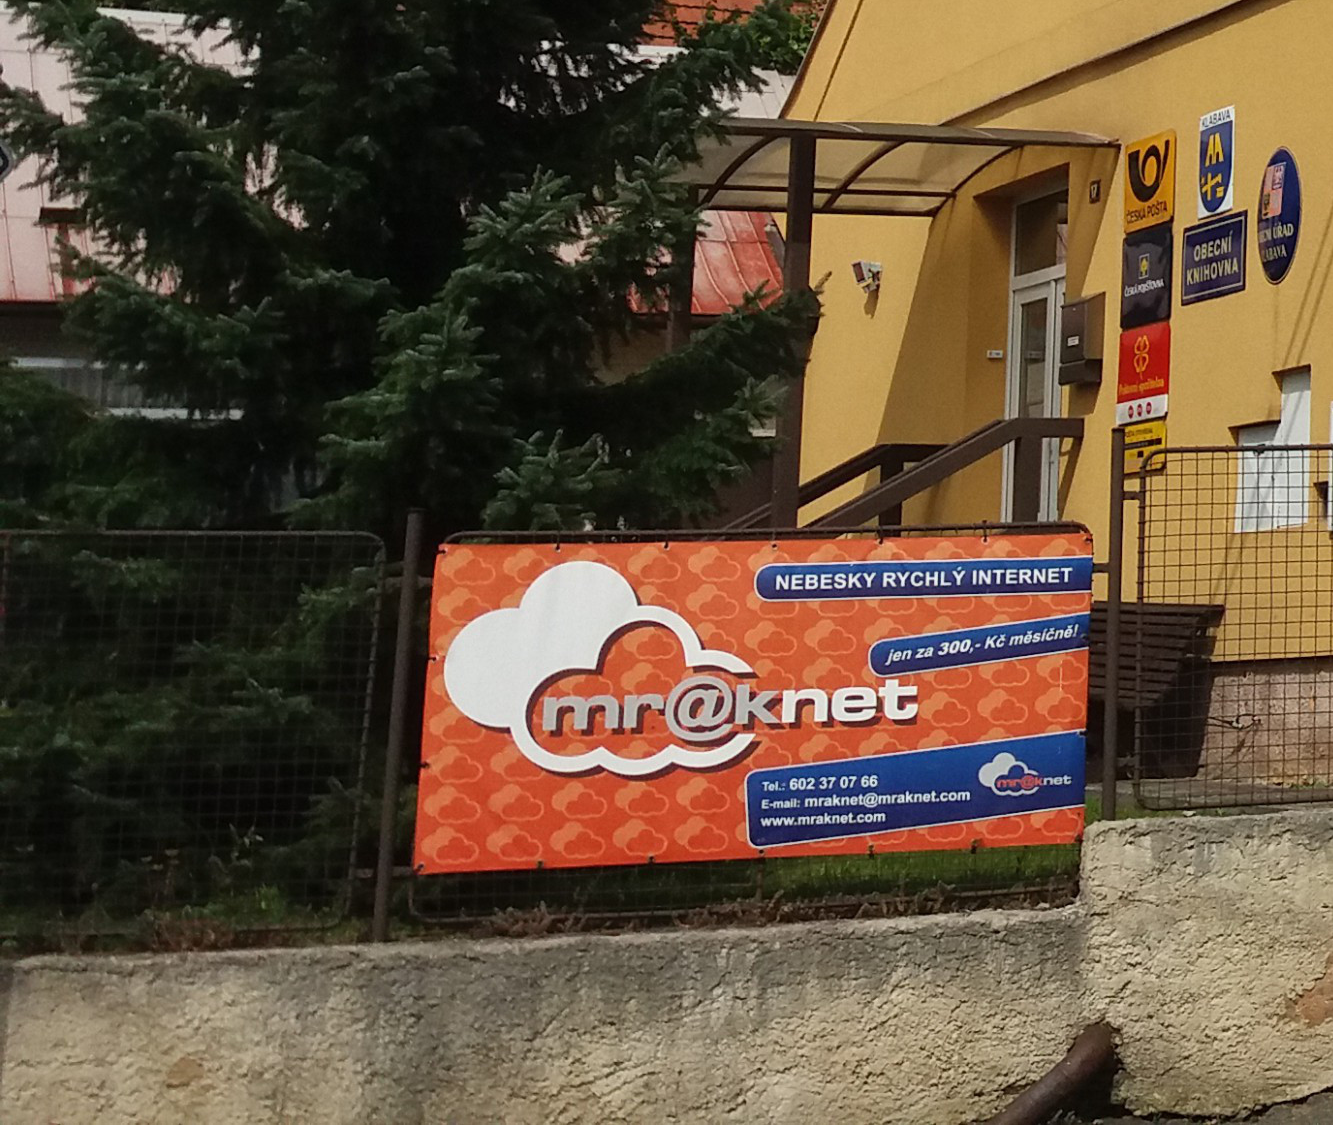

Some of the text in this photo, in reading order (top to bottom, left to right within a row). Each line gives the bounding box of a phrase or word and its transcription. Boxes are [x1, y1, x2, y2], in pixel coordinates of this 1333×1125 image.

[1193, 230, 1233, 262] OBECNÍ
[1186, 257, 1240, 286] KNIHOVNA
[775, 566, 1074, 591] NEBESKY RYCHLÝ INTERNET
[885, 624, 1080, 665] jen za 300,- Kč měsíčně!
[541, 675, 919, 742] mr@knet
[762, 775, 878, 792] Tel.: 602 37 07 66
[996, 774, 1072, 790] mr@knet
[761, 790, 971, 810] E-mail: mraknet@mraknet.com
[760, 811, 886, 827] www.mraknet.com
